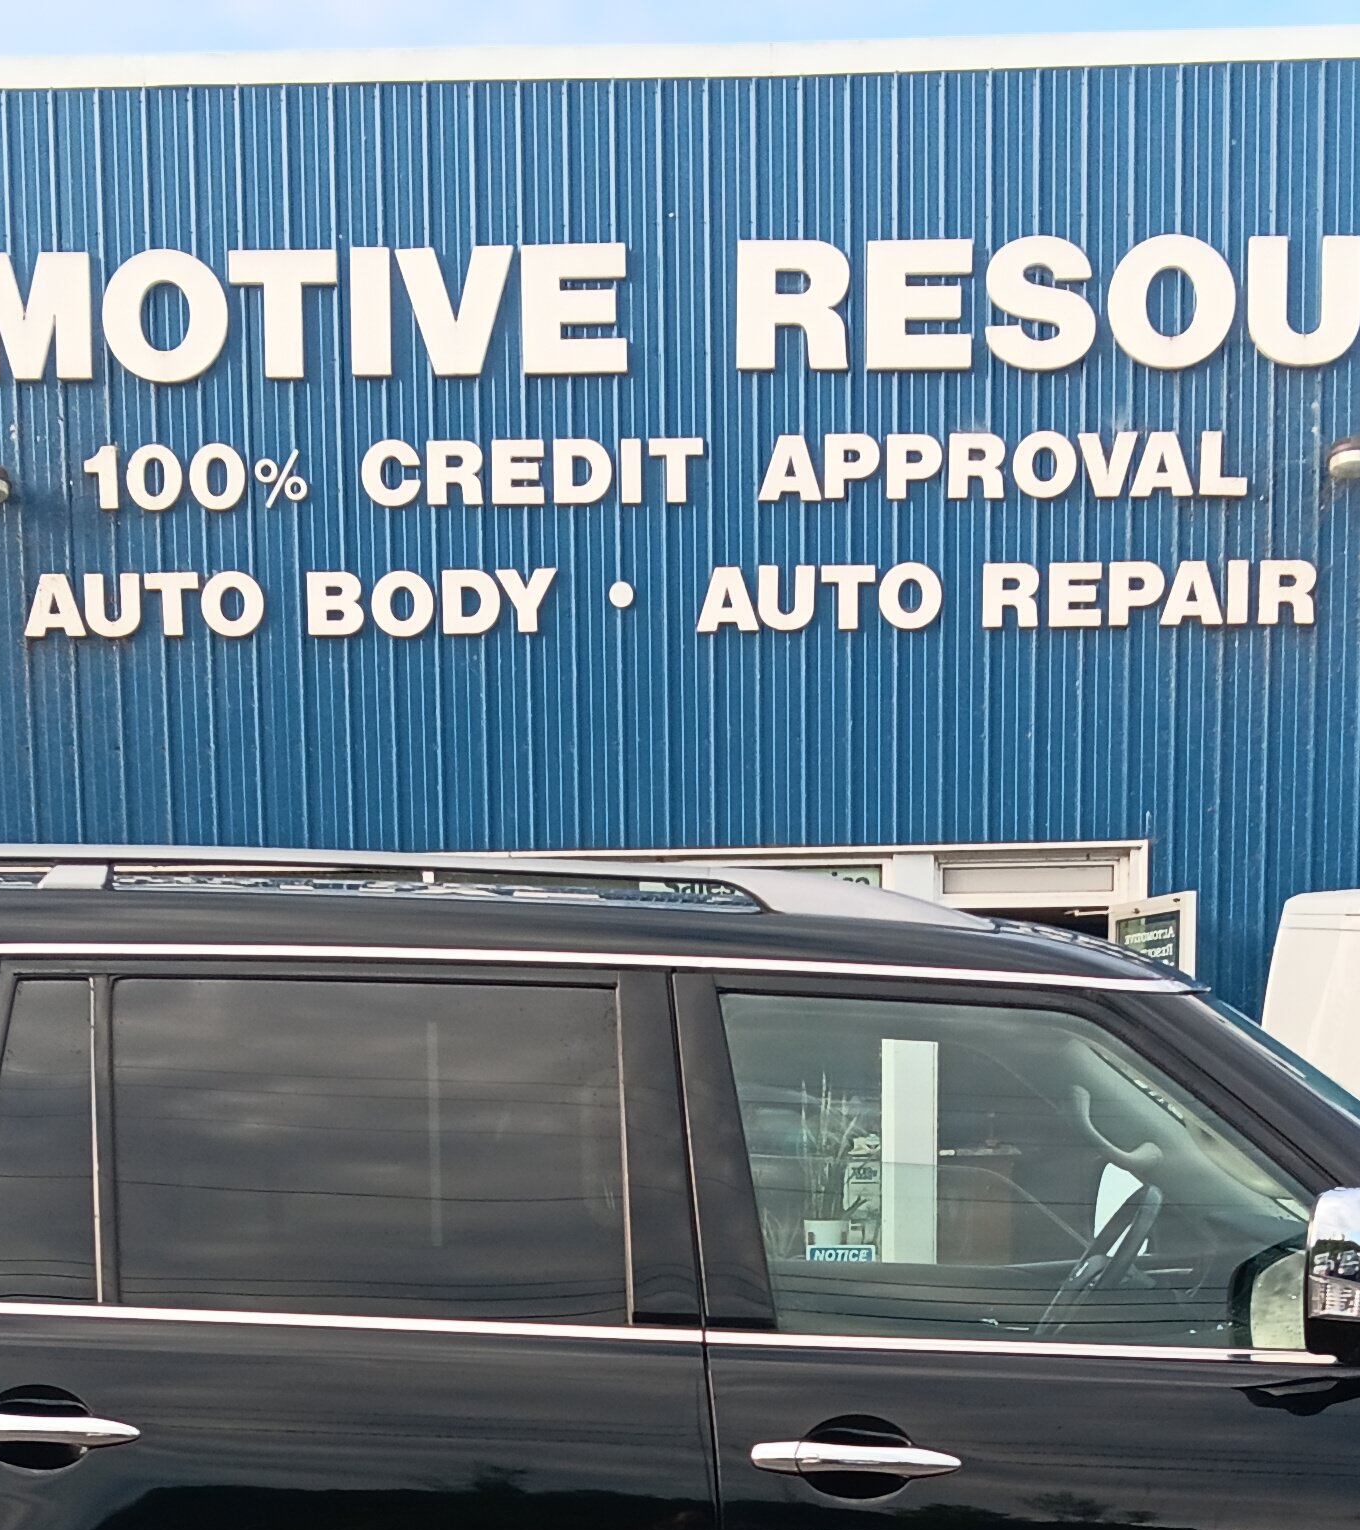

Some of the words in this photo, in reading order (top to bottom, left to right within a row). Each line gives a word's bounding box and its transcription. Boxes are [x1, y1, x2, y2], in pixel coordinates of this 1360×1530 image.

[83, 441, 309, 512] 100%
[361, 436, 704, 507] CREDIT
[757, 429, 1248, 502] APPROVAL
[24, 570, 264, 638] AUTO
[306, 567, 557, 637] BODY
[696, 561, 942, 632] AUTO
[982, 558, 1317, 628] REPAIR
[813, 1249, 869, 1262] NOTICE
